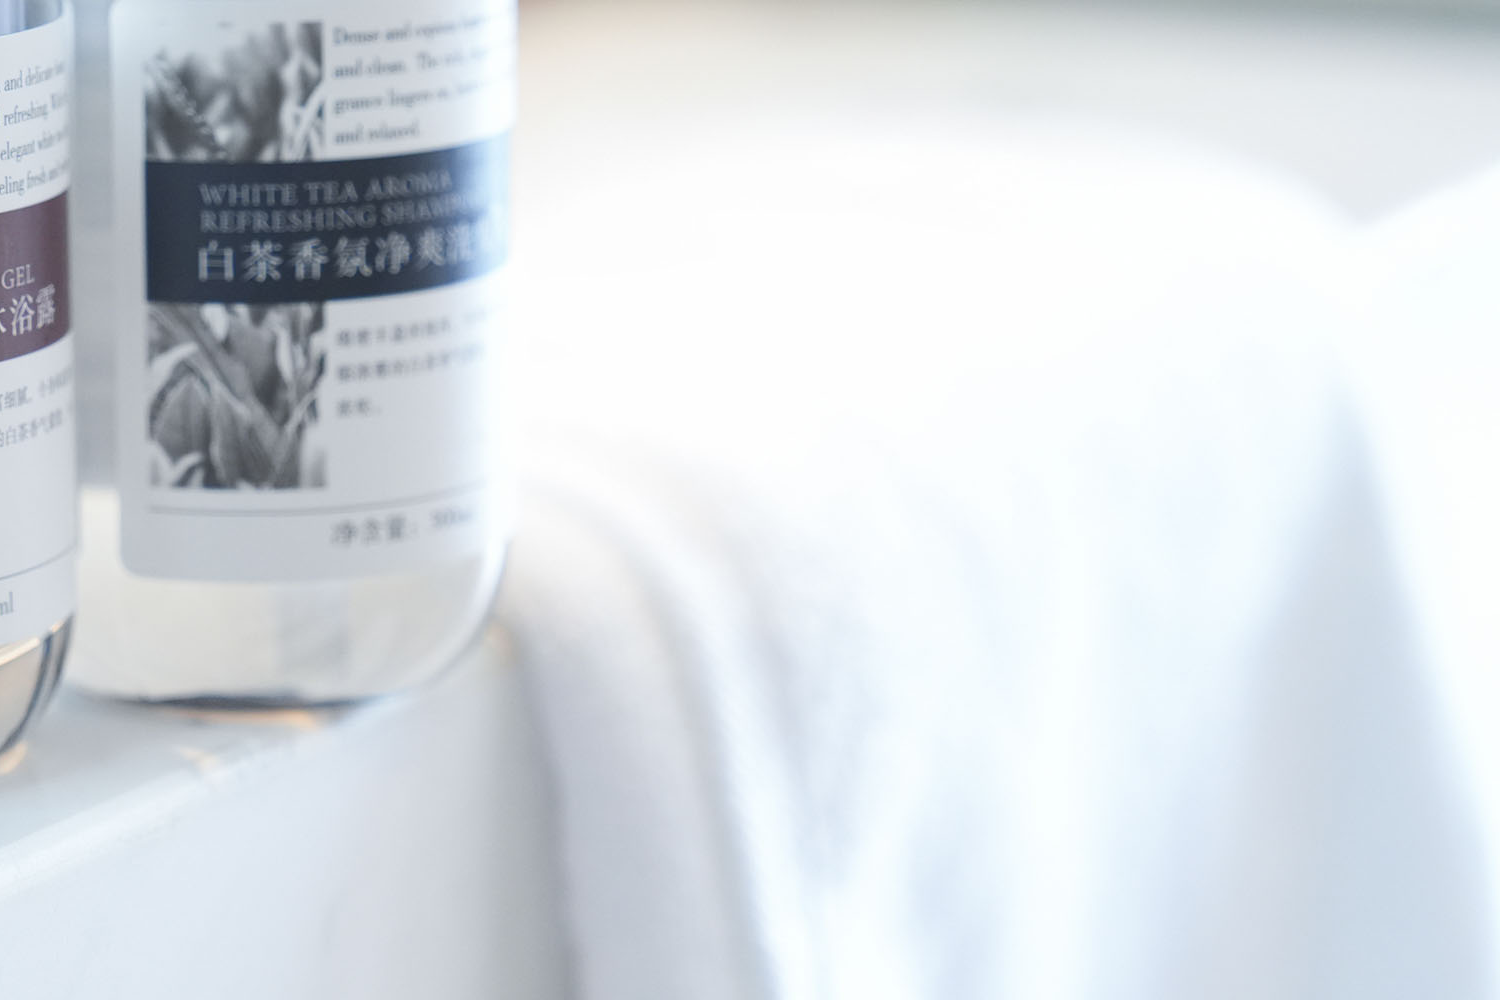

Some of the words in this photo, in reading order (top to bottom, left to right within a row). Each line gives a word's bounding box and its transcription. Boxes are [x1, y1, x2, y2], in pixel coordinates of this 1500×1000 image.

[4, 70, 23, 92] and
[0, 140, 36, 164] elegant
[199, 182, 299, 206] WHITE
[303, 180, 358, 204] TEA
[364, 170, 452, 198] AROMA
[199, 207, 377, 234] REFRESHING
[380, 190, 480, 227] SHAMP
[1, 263, 36, 291] GEL
